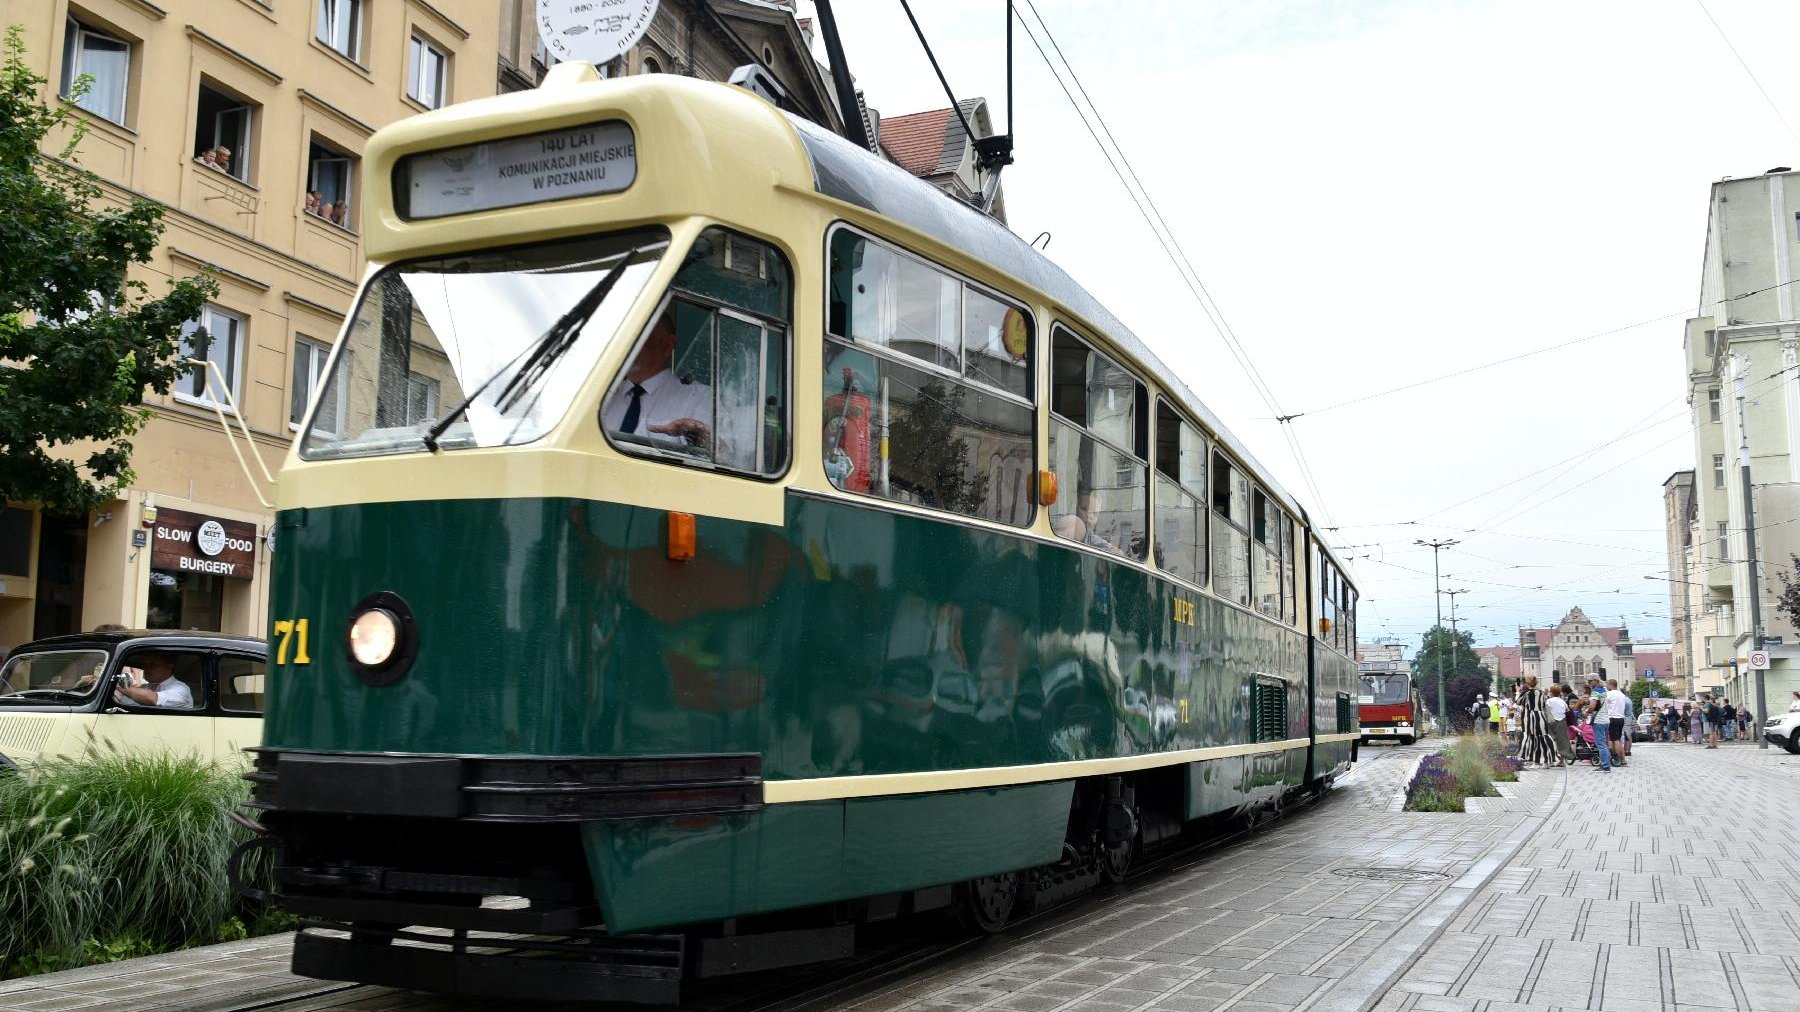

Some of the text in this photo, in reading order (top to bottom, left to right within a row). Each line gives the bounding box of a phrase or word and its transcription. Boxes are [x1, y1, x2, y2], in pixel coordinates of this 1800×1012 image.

[541, 134, 595, 153] 140 LAT
[499, 154, 577, 179] KOMUNIKACJI
[533, 167, 606, 189] W POZNANIU
[157, 527, 192, 543] SLOW
[180, 557, 235, 575] BURGERY
[1173, 597, 1194, 627] MPK
[274, 618, 310, 665] 71
[1180, 698, 1189, 723] 71
